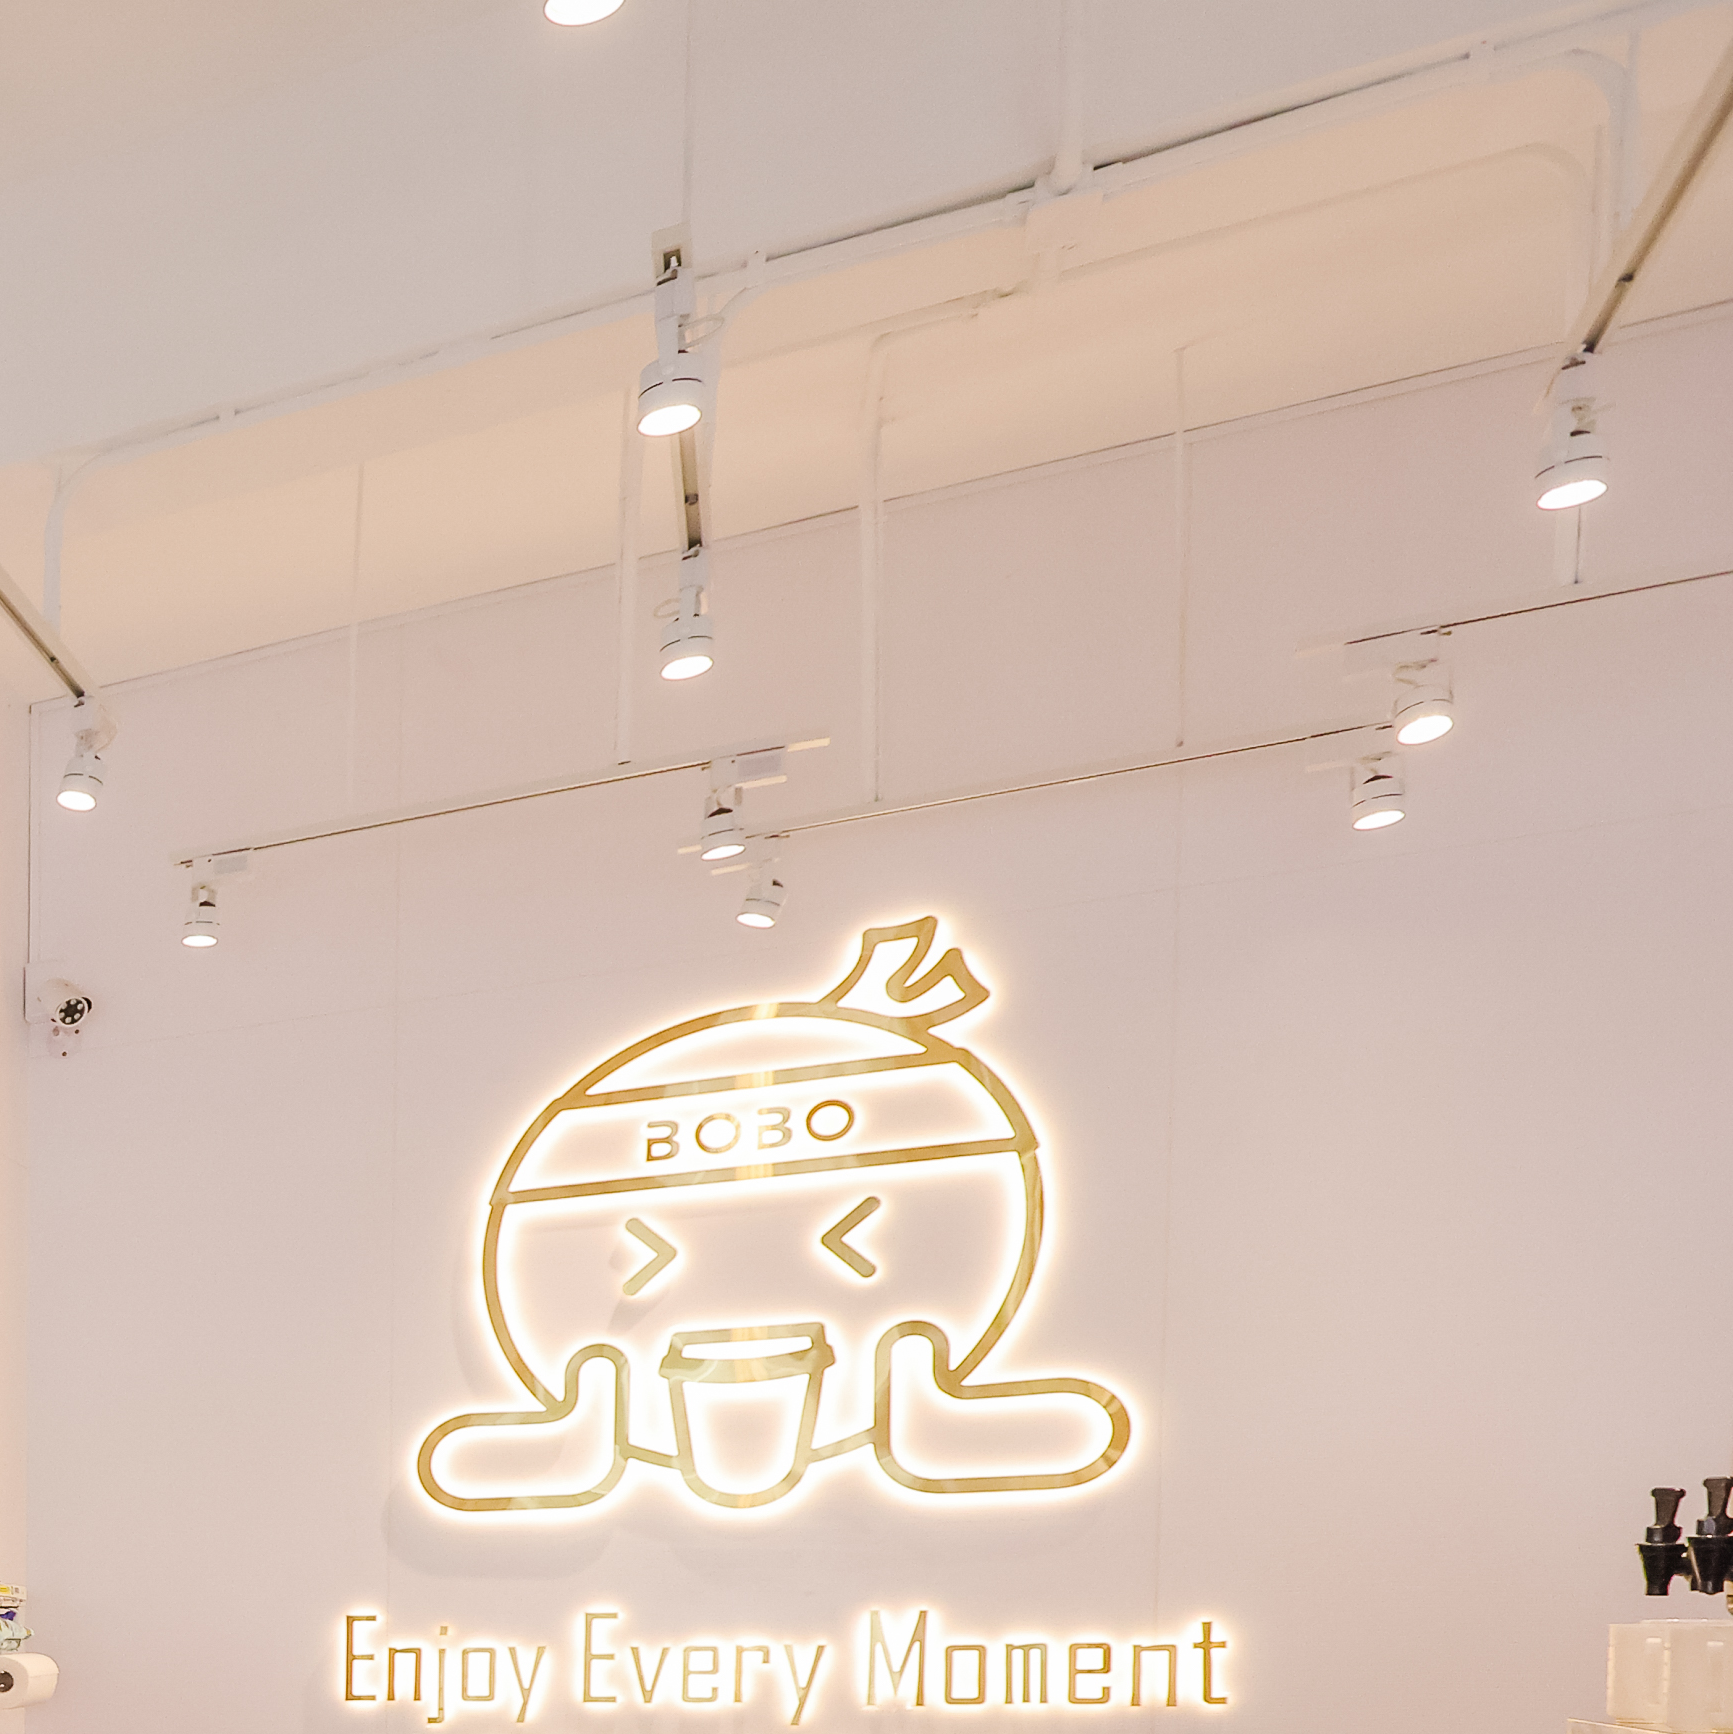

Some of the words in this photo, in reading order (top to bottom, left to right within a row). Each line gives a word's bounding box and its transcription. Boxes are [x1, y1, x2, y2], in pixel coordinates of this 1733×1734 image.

[645, 1098, 855, 1163] BOBO
[343, 1612, 547, 1725] Enjoy
[581, 1611, 826, 1727] Every
[865, 1608, 1230, 1709] Moment
